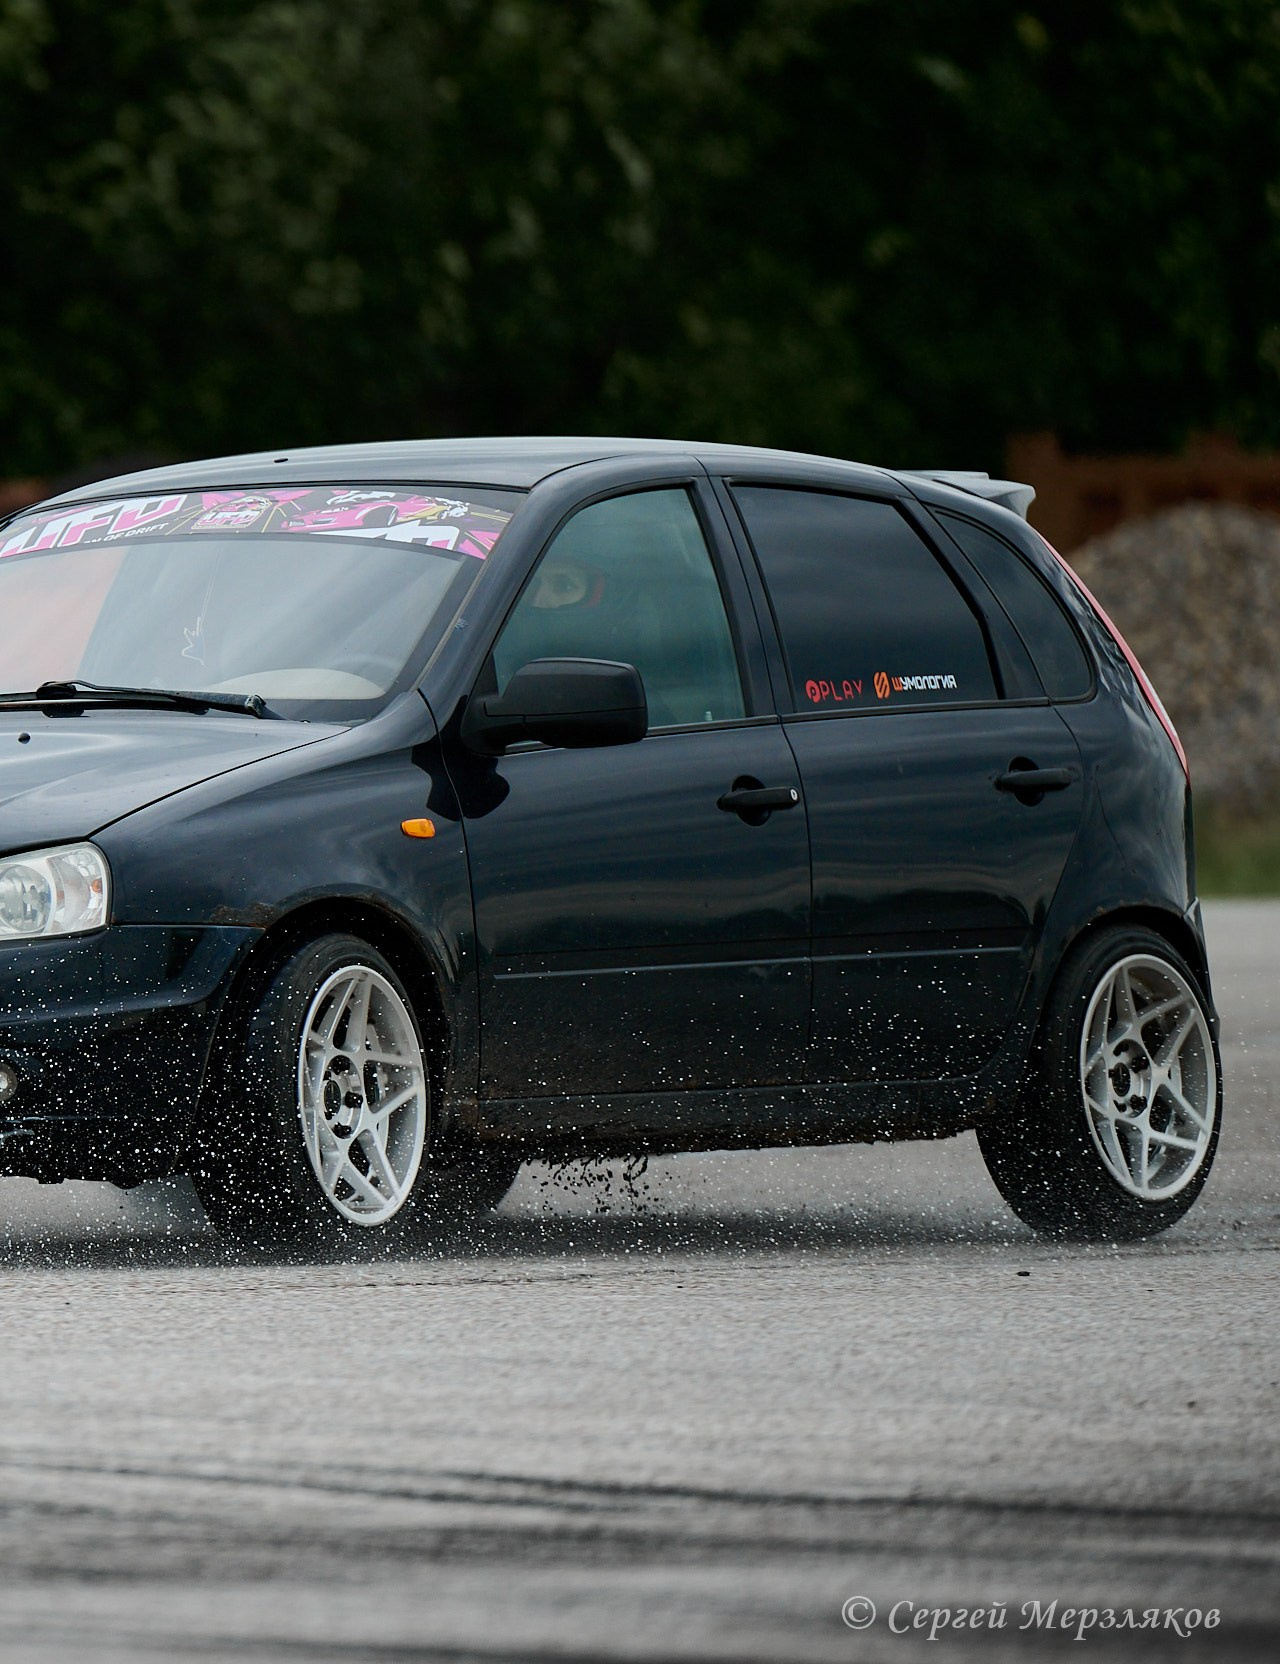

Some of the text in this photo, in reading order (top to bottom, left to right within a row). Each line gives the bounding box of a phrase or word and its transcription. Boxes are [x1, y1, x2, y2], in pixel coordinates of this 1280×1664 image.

[103, 532, 125, 542] OF
[124, 522, 170, 538] DRIFT
[891, 674, 958, 692] ШУМОЛОГИЯ
